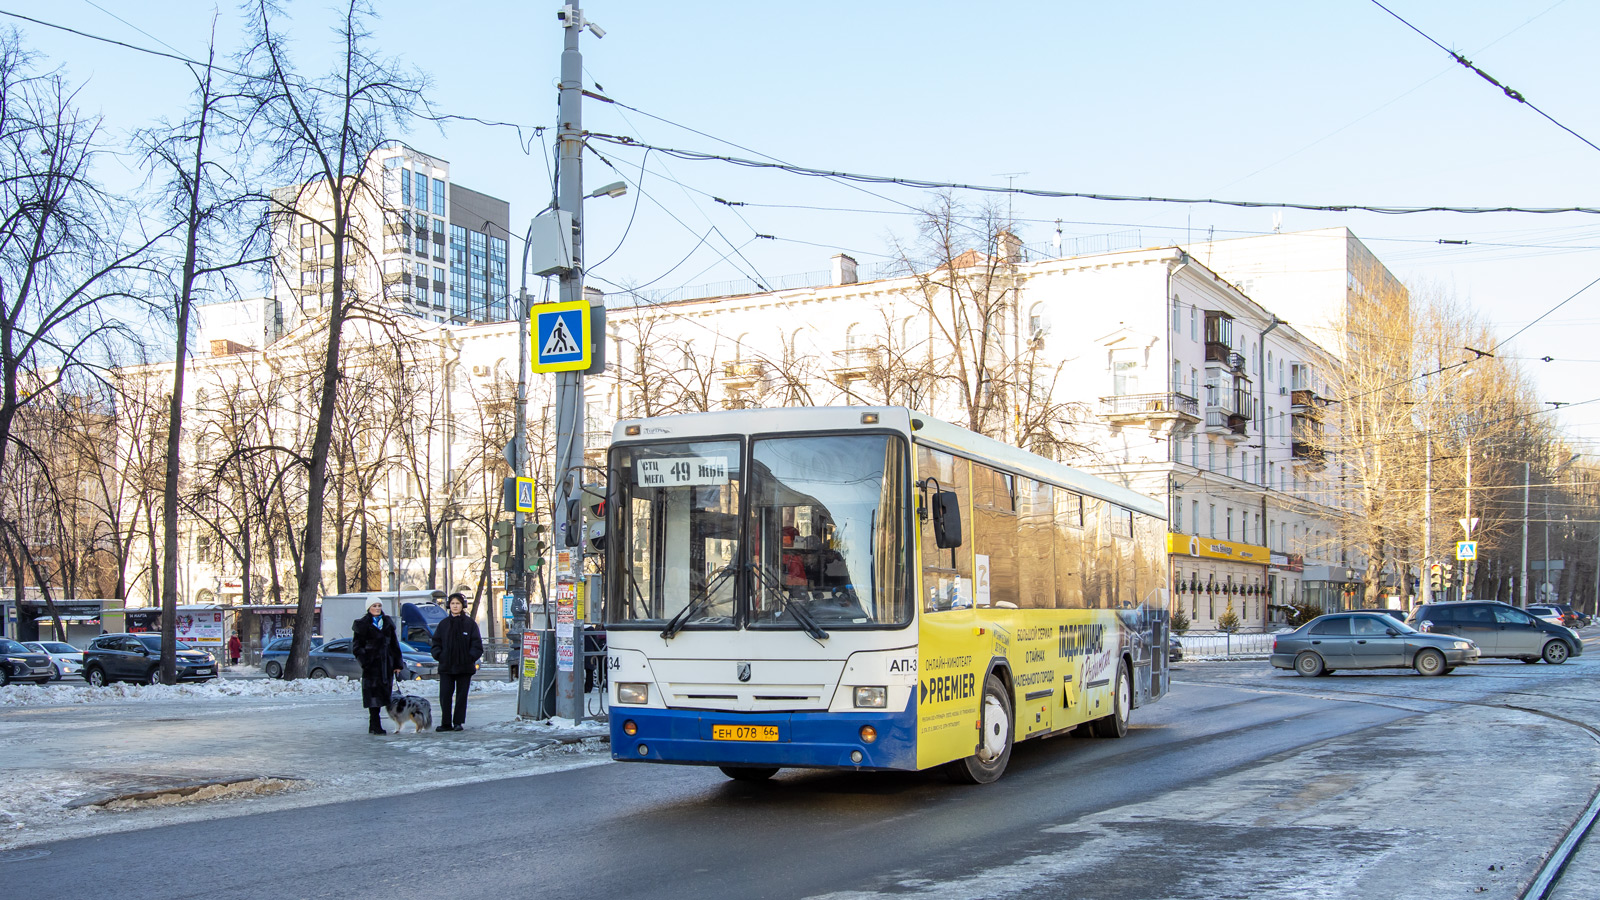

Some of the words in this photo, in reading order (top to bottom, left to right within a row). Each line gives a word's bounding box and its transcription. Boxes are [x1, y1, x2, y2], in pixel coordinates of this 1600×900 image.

[642, 461, 659, 471] СТЦ
[670, 461, 691, 482] 49
[644, 474, 665, 484] МЕГА
[1017, 626, 1037, 641] БОЛЬШОЙ
[1038, 627, 1053, 640] СЕРИАЛ
[1059, 624, 1104, 663] ПОДСЛУШАНО
[926, 655, 972, 671] ОНЛАЙН-КИНОТЕАТР
[1029, 648, 1046, 663] ТАЙНАХ
[1040, 669, 1055, 684] ГОРОДА
[929, 673, 975, 704] PREMIER
[718, 729, 732, 738] ЕН
[736, 727, 757, 739] 078
[763, 726, 775, 736] 66
